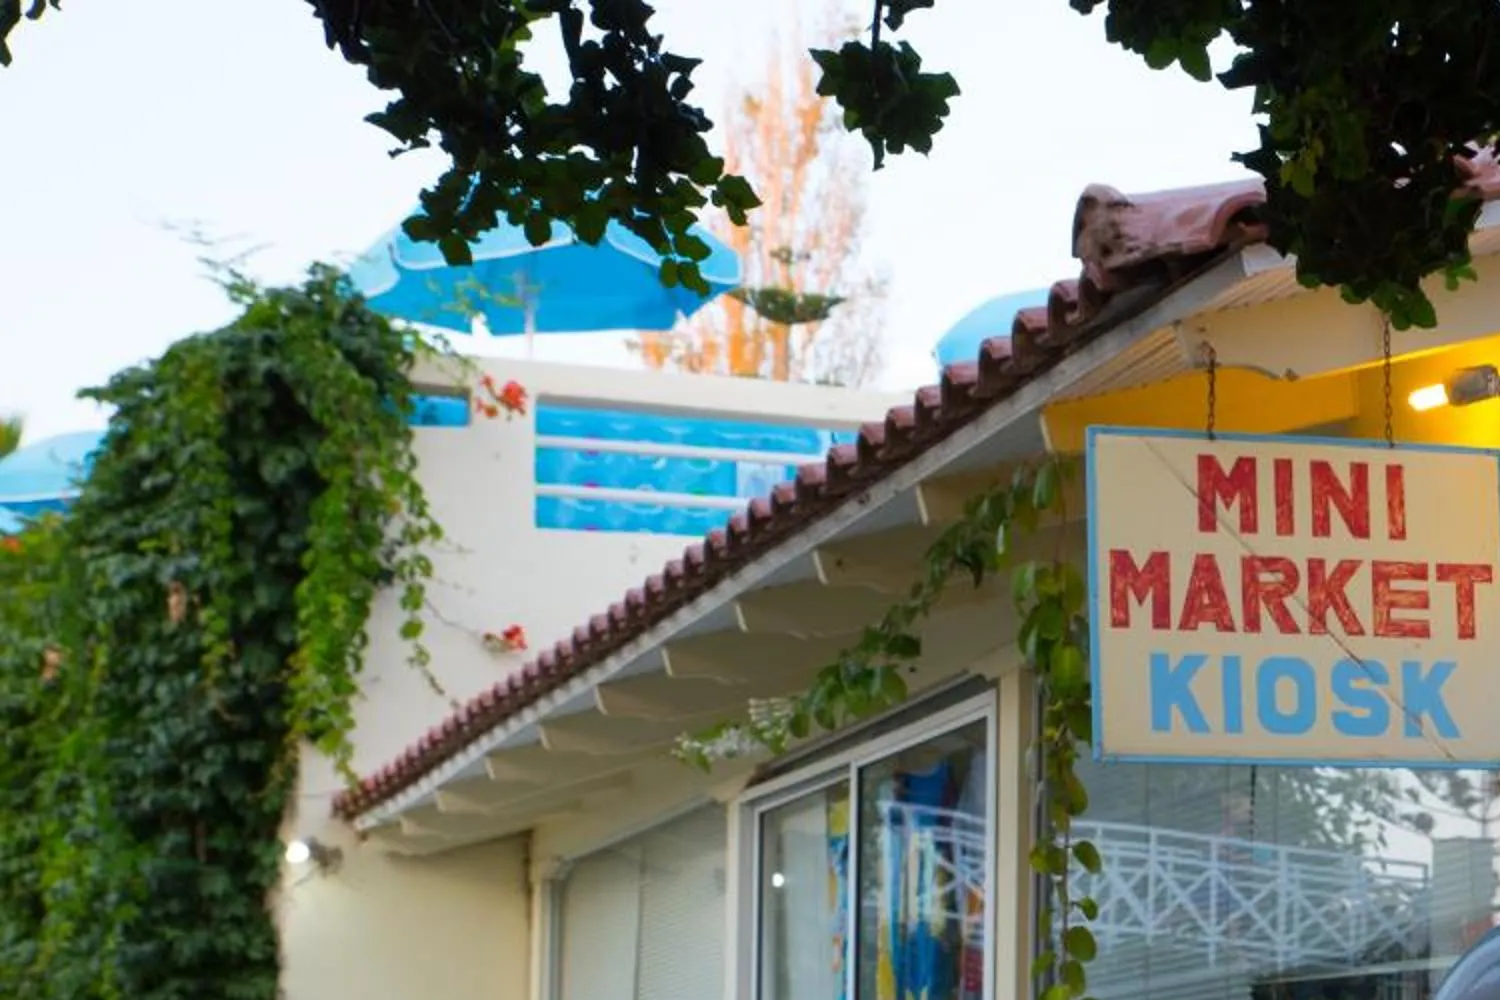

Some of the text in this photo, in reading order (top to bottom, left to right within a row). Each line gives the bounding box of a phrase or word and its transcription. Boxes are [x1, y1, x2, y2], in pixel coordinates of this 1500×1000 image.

[1197, 454, 1407, 540] MINI
[1109, 549, 1493, 640] MARKET
[1149, 653, 1462, 738] KIOSK
